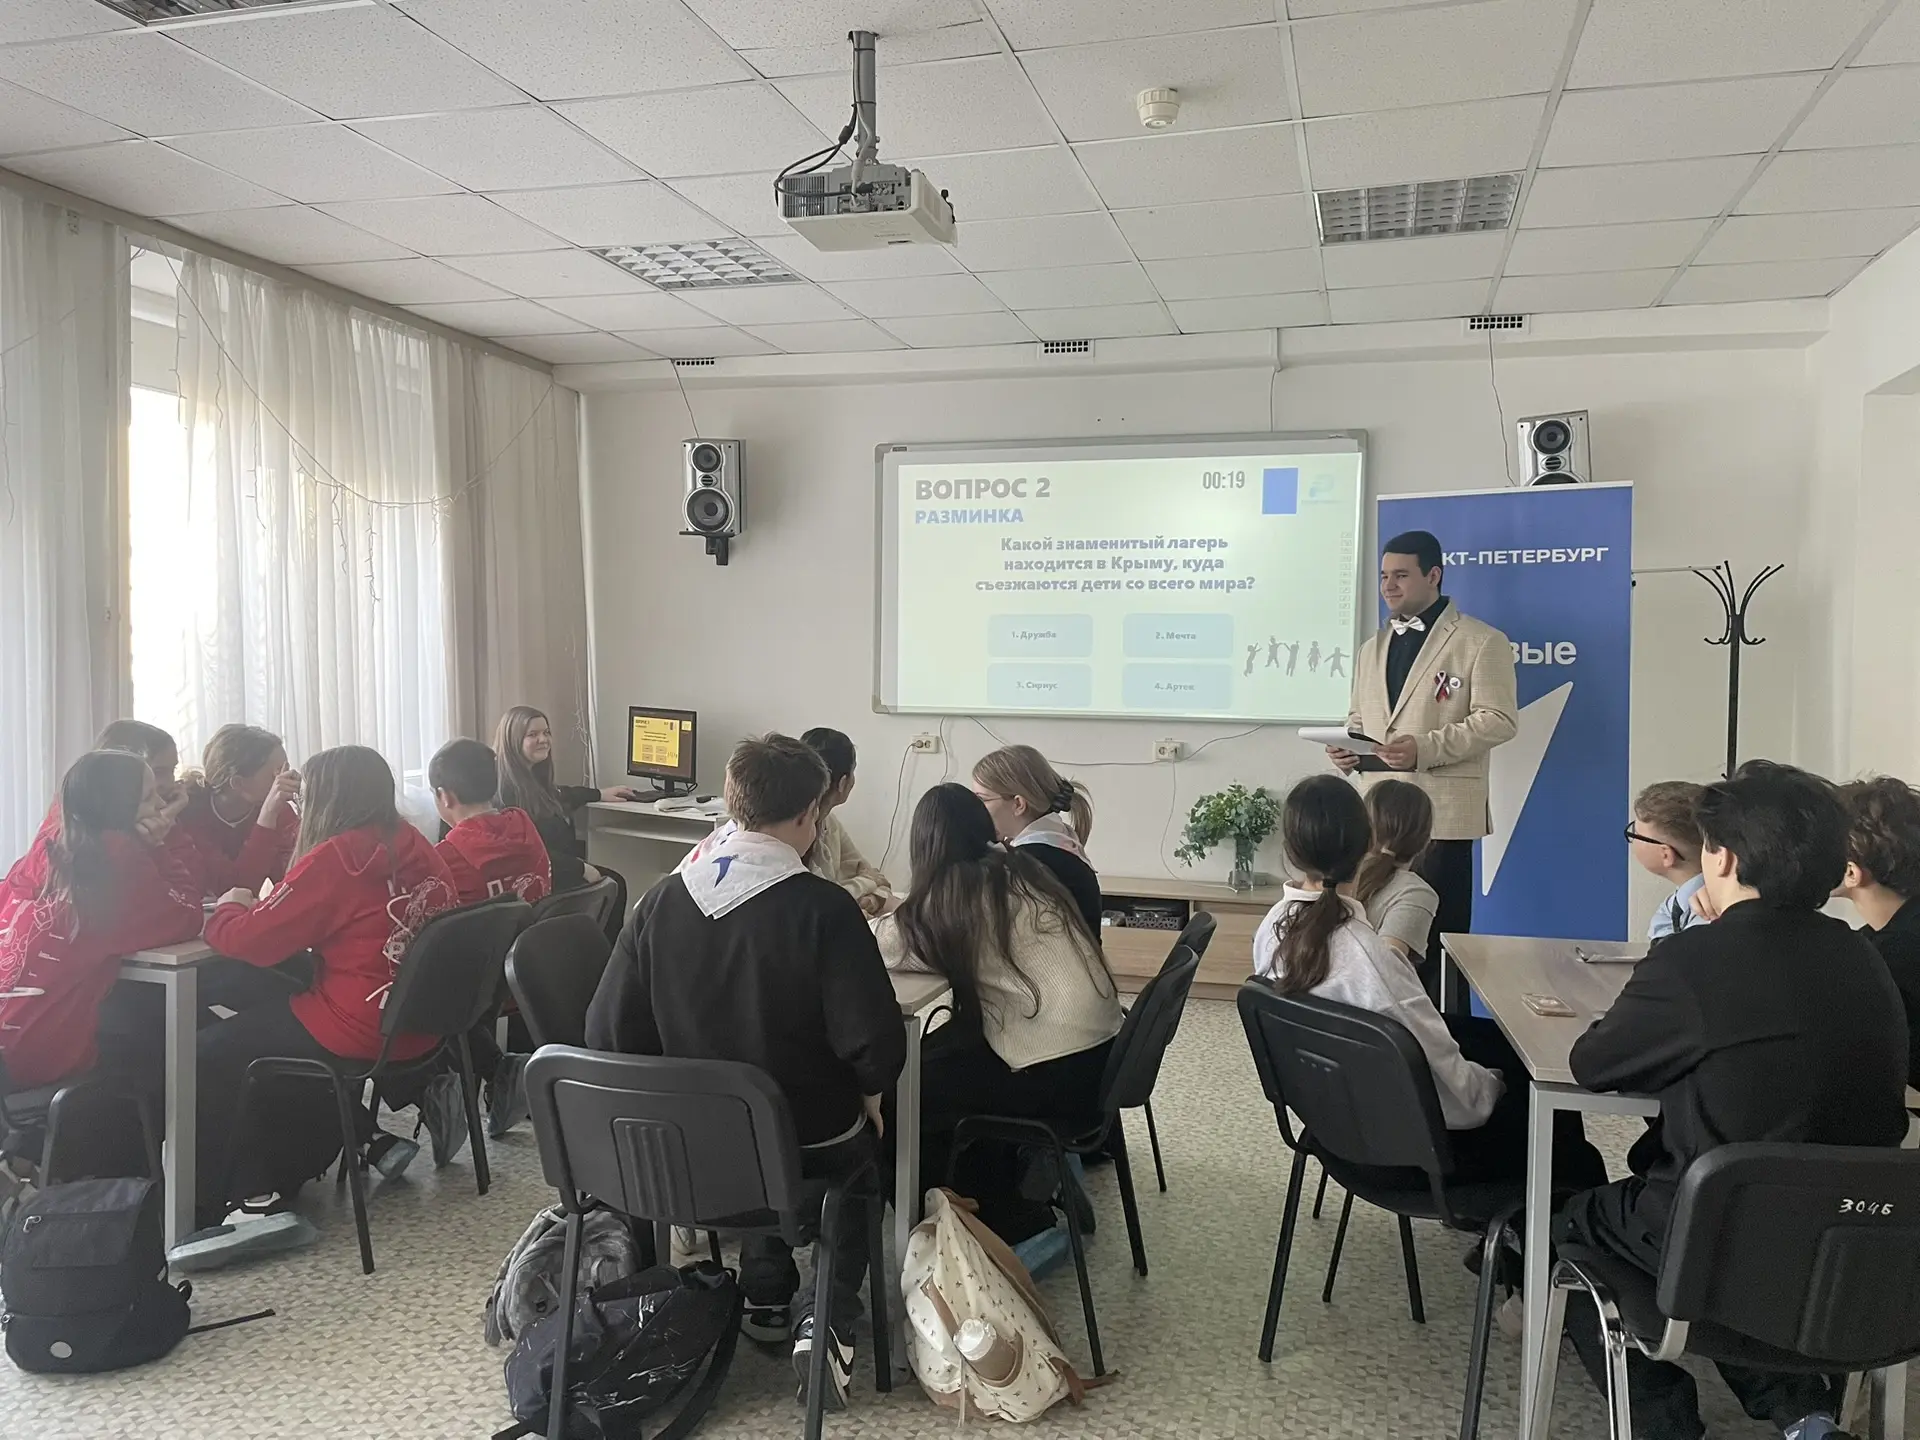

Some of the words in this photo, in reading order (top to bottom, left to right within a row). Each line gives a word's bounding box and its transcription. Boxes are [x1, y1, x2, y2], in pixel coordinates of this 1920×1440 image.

[915, 478, 1027, 500] ВОПРОС
[1035, 477, 1050, 498] 2
[1202, 471, 1245, 489] 00:19
[915, 508, 1024, 524] РАЗМИНКА
[1001, 536, 1053, 551] Какой
[1056, 535, 1165, 550] знаменитый
[1167, 537, 1229, 552] лагерь
[1004, 557, 1093, 573] находится
[1097, 560, 1106, 569] в
[1111, 556, 1178, 573] Крыму,
[1182, 557, 1225, 571] куда
[975, 580, 1078, 592] съезжаются
[1081, 578, 1121, 593] дети
[1126, 580, 1145, 590] со
[1148, 579, 1195, 590] всего
[1199, 576, 1256, 593] мира?
[1020, 630, 1057, 641] Дружба
[1166, 632, 1197, 641] Мечта
